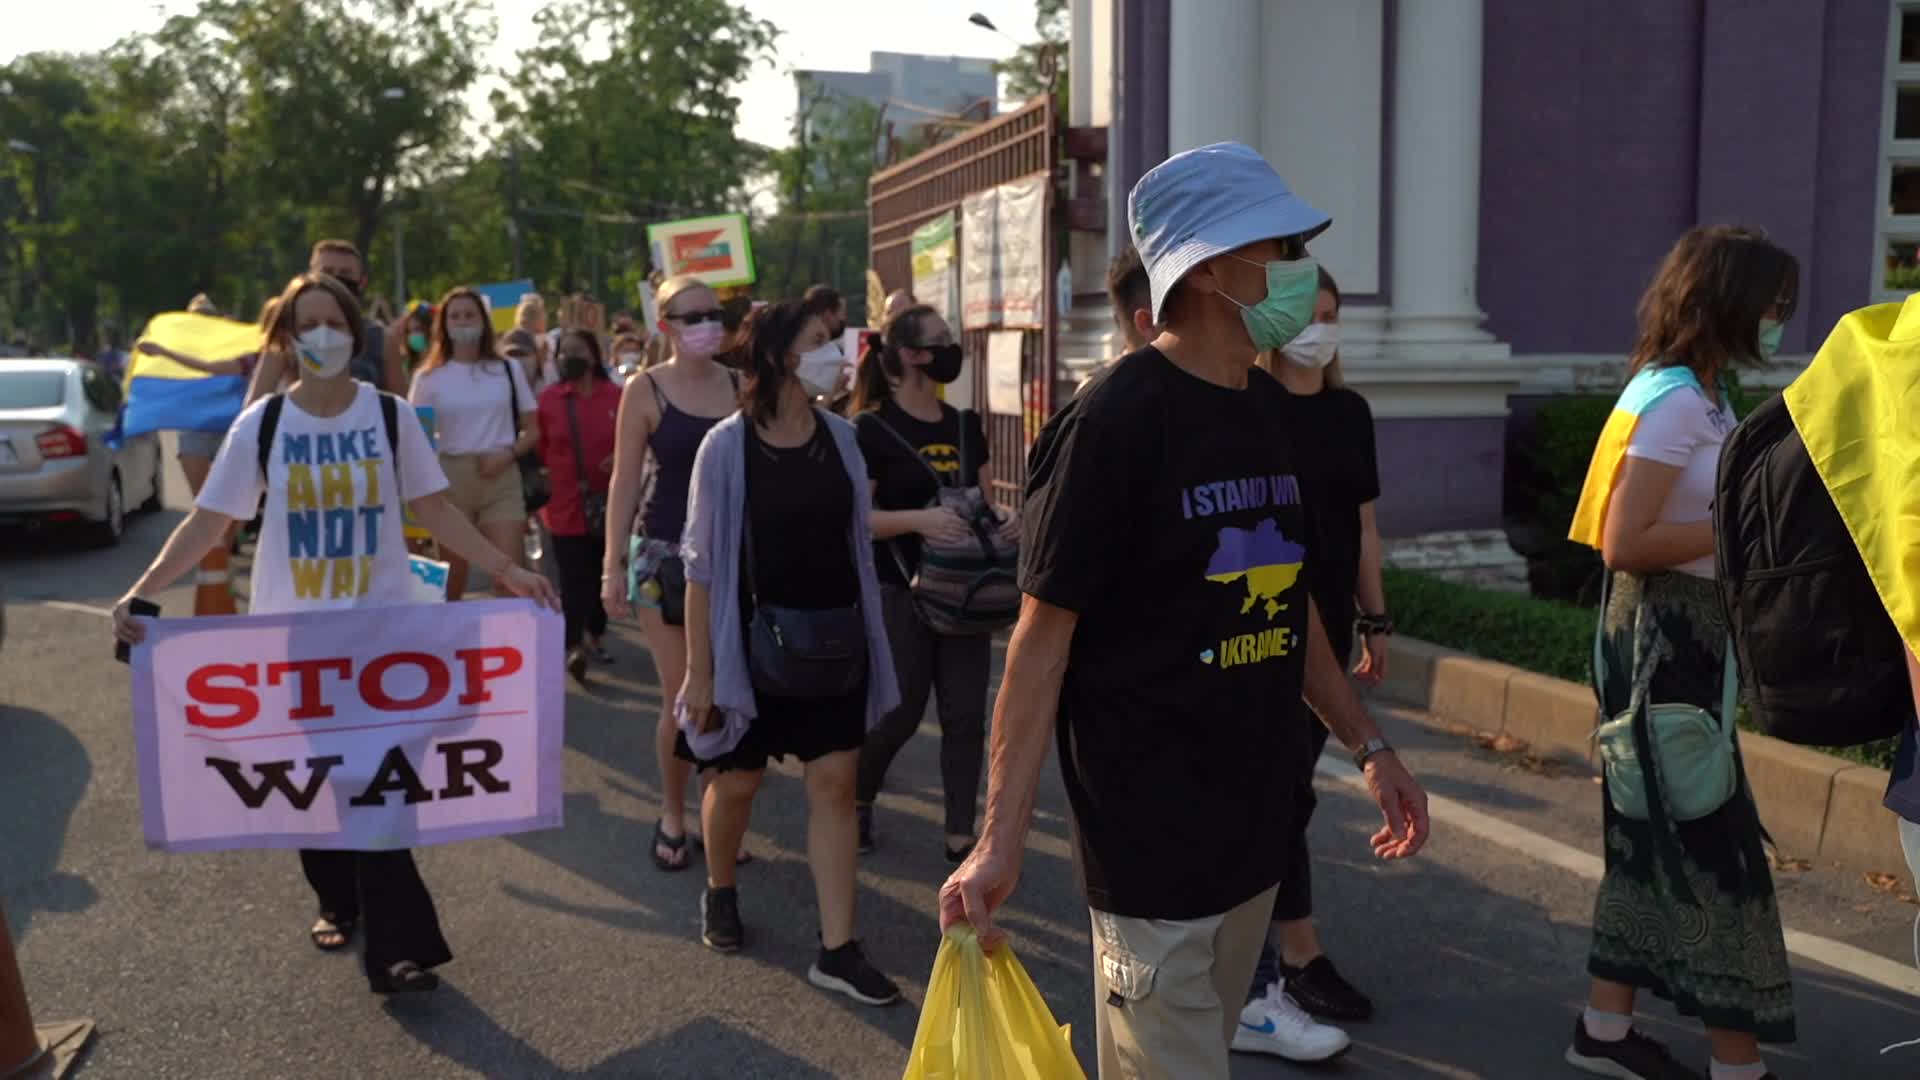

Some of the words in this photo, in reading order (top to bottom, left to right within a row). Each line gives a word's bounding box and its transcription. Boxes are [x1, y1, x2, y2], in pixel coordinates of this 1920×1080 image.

[282, 427, 381, 464] MAKE
[287, 458, 384, 511] ART
[1181, 487, 1193, 519] I
[1194, 477, 1267, 516] STAND
[287, 505, 384, 558] NOT
[184, 646, 523, 729] STOP
[205, 739, 511, 811] WAR
